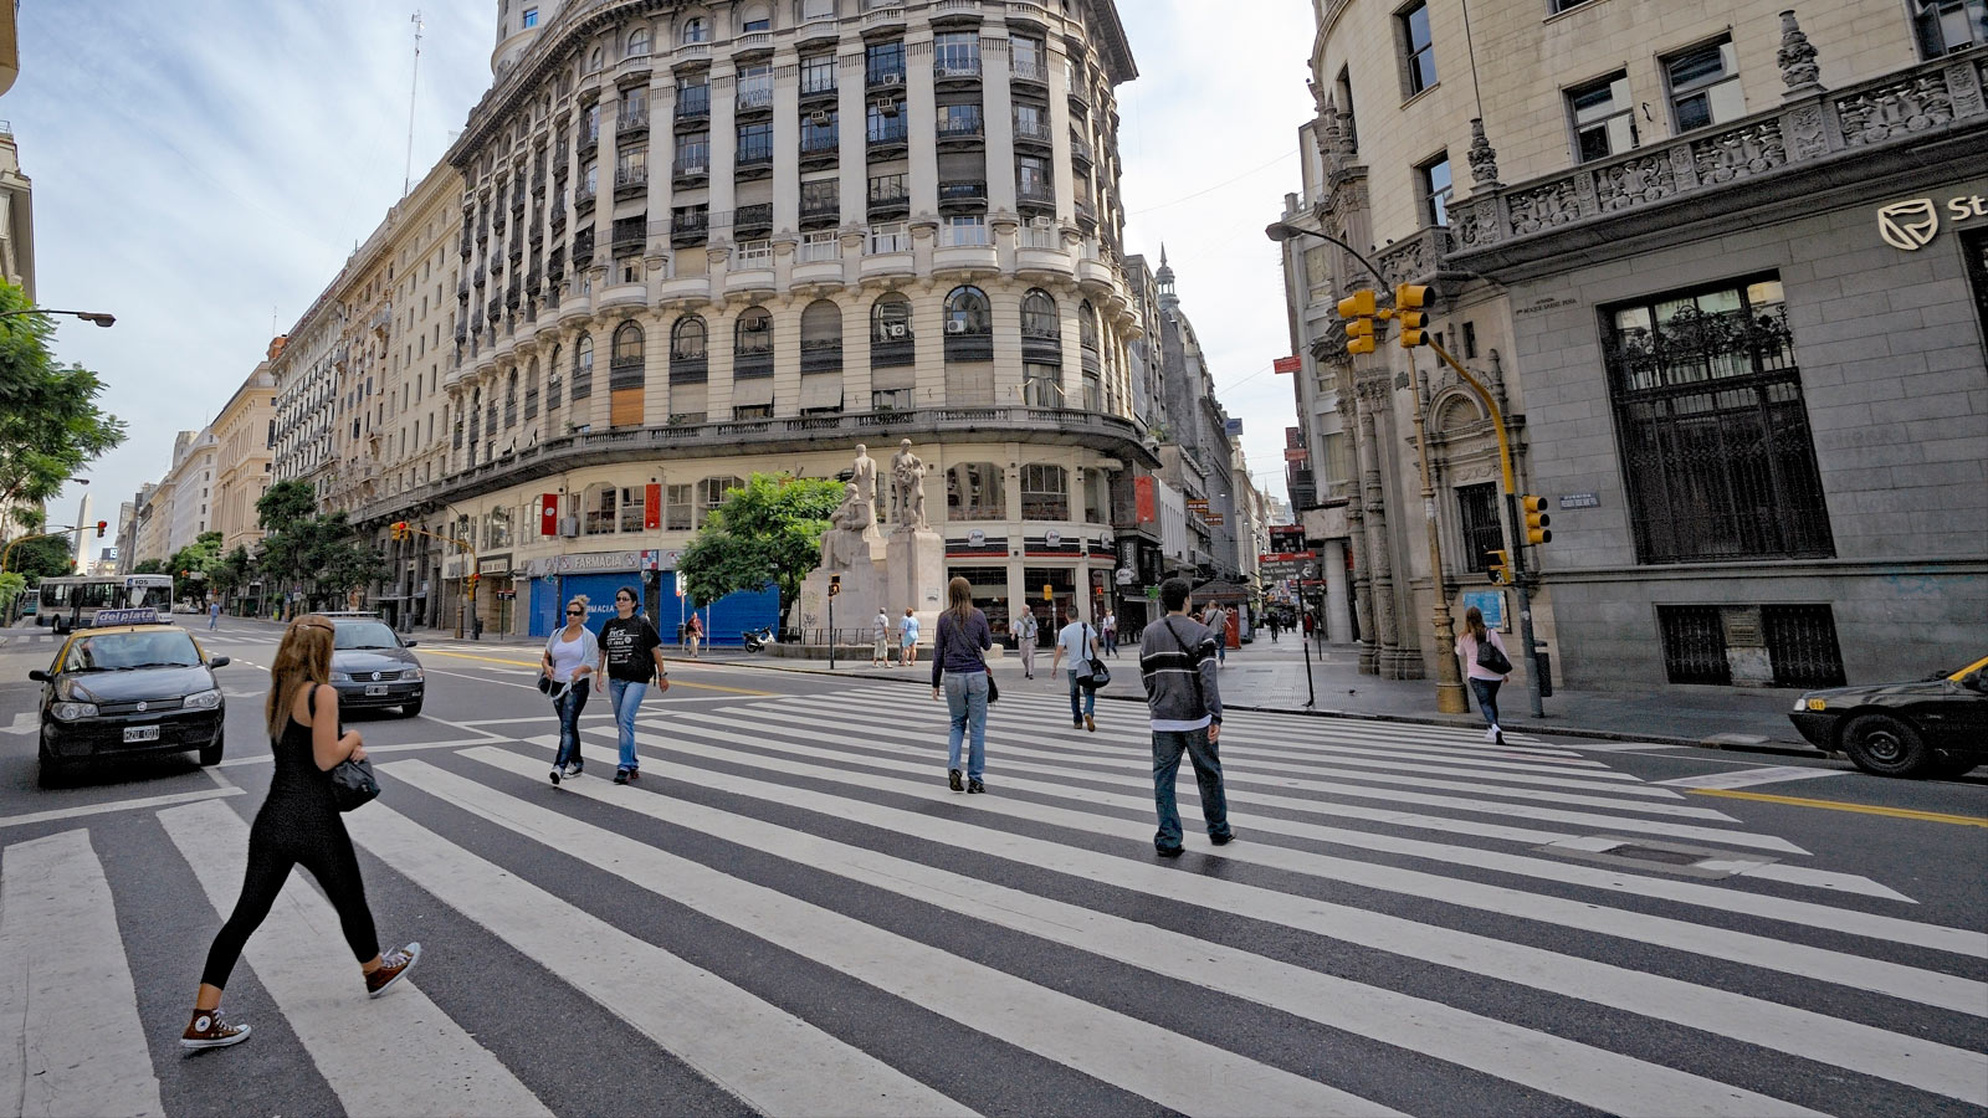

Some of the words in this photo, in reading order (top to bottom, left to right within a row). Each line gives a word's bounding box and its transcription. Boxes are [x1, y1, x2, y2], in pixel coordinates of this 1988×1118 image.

[1947, 194, 1988, 221] St
[574, 555, 623, 569] FARMACIA
[587, 604, 615, 613] RMACIA
